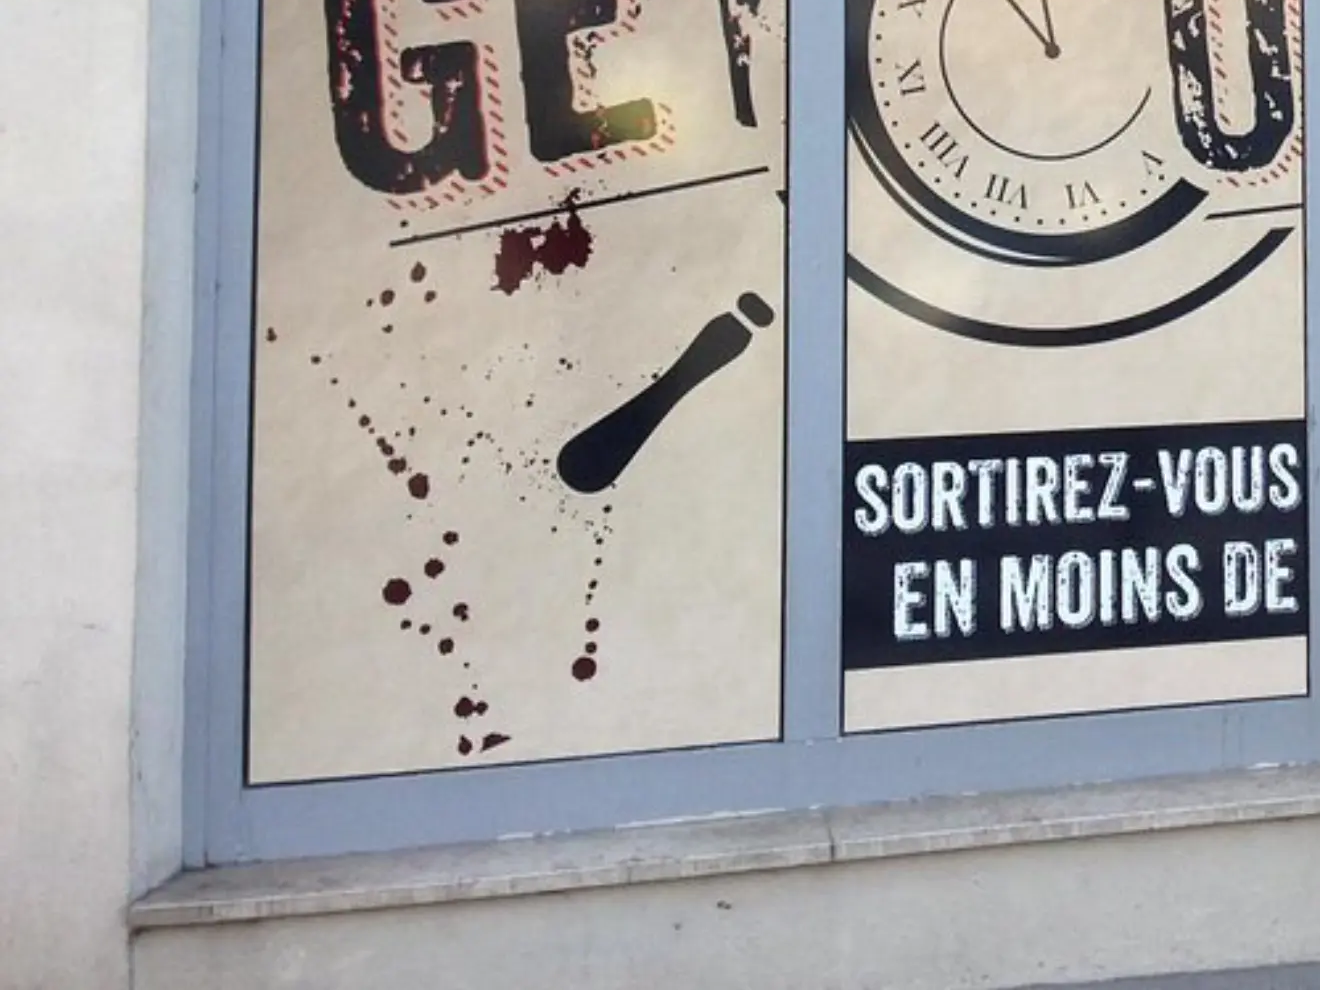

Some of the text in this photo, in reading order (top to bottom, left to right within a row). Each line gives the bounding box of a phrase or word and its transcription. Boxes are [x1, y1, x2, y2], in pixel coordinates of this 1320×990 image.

[854, 443, 1303, 536] SORTIREZ-VOUS
[893, 558, 977, 640] EN
[1000, 543, 1203, 634] MOINS
[1224, 537, 1299, 616] DE
